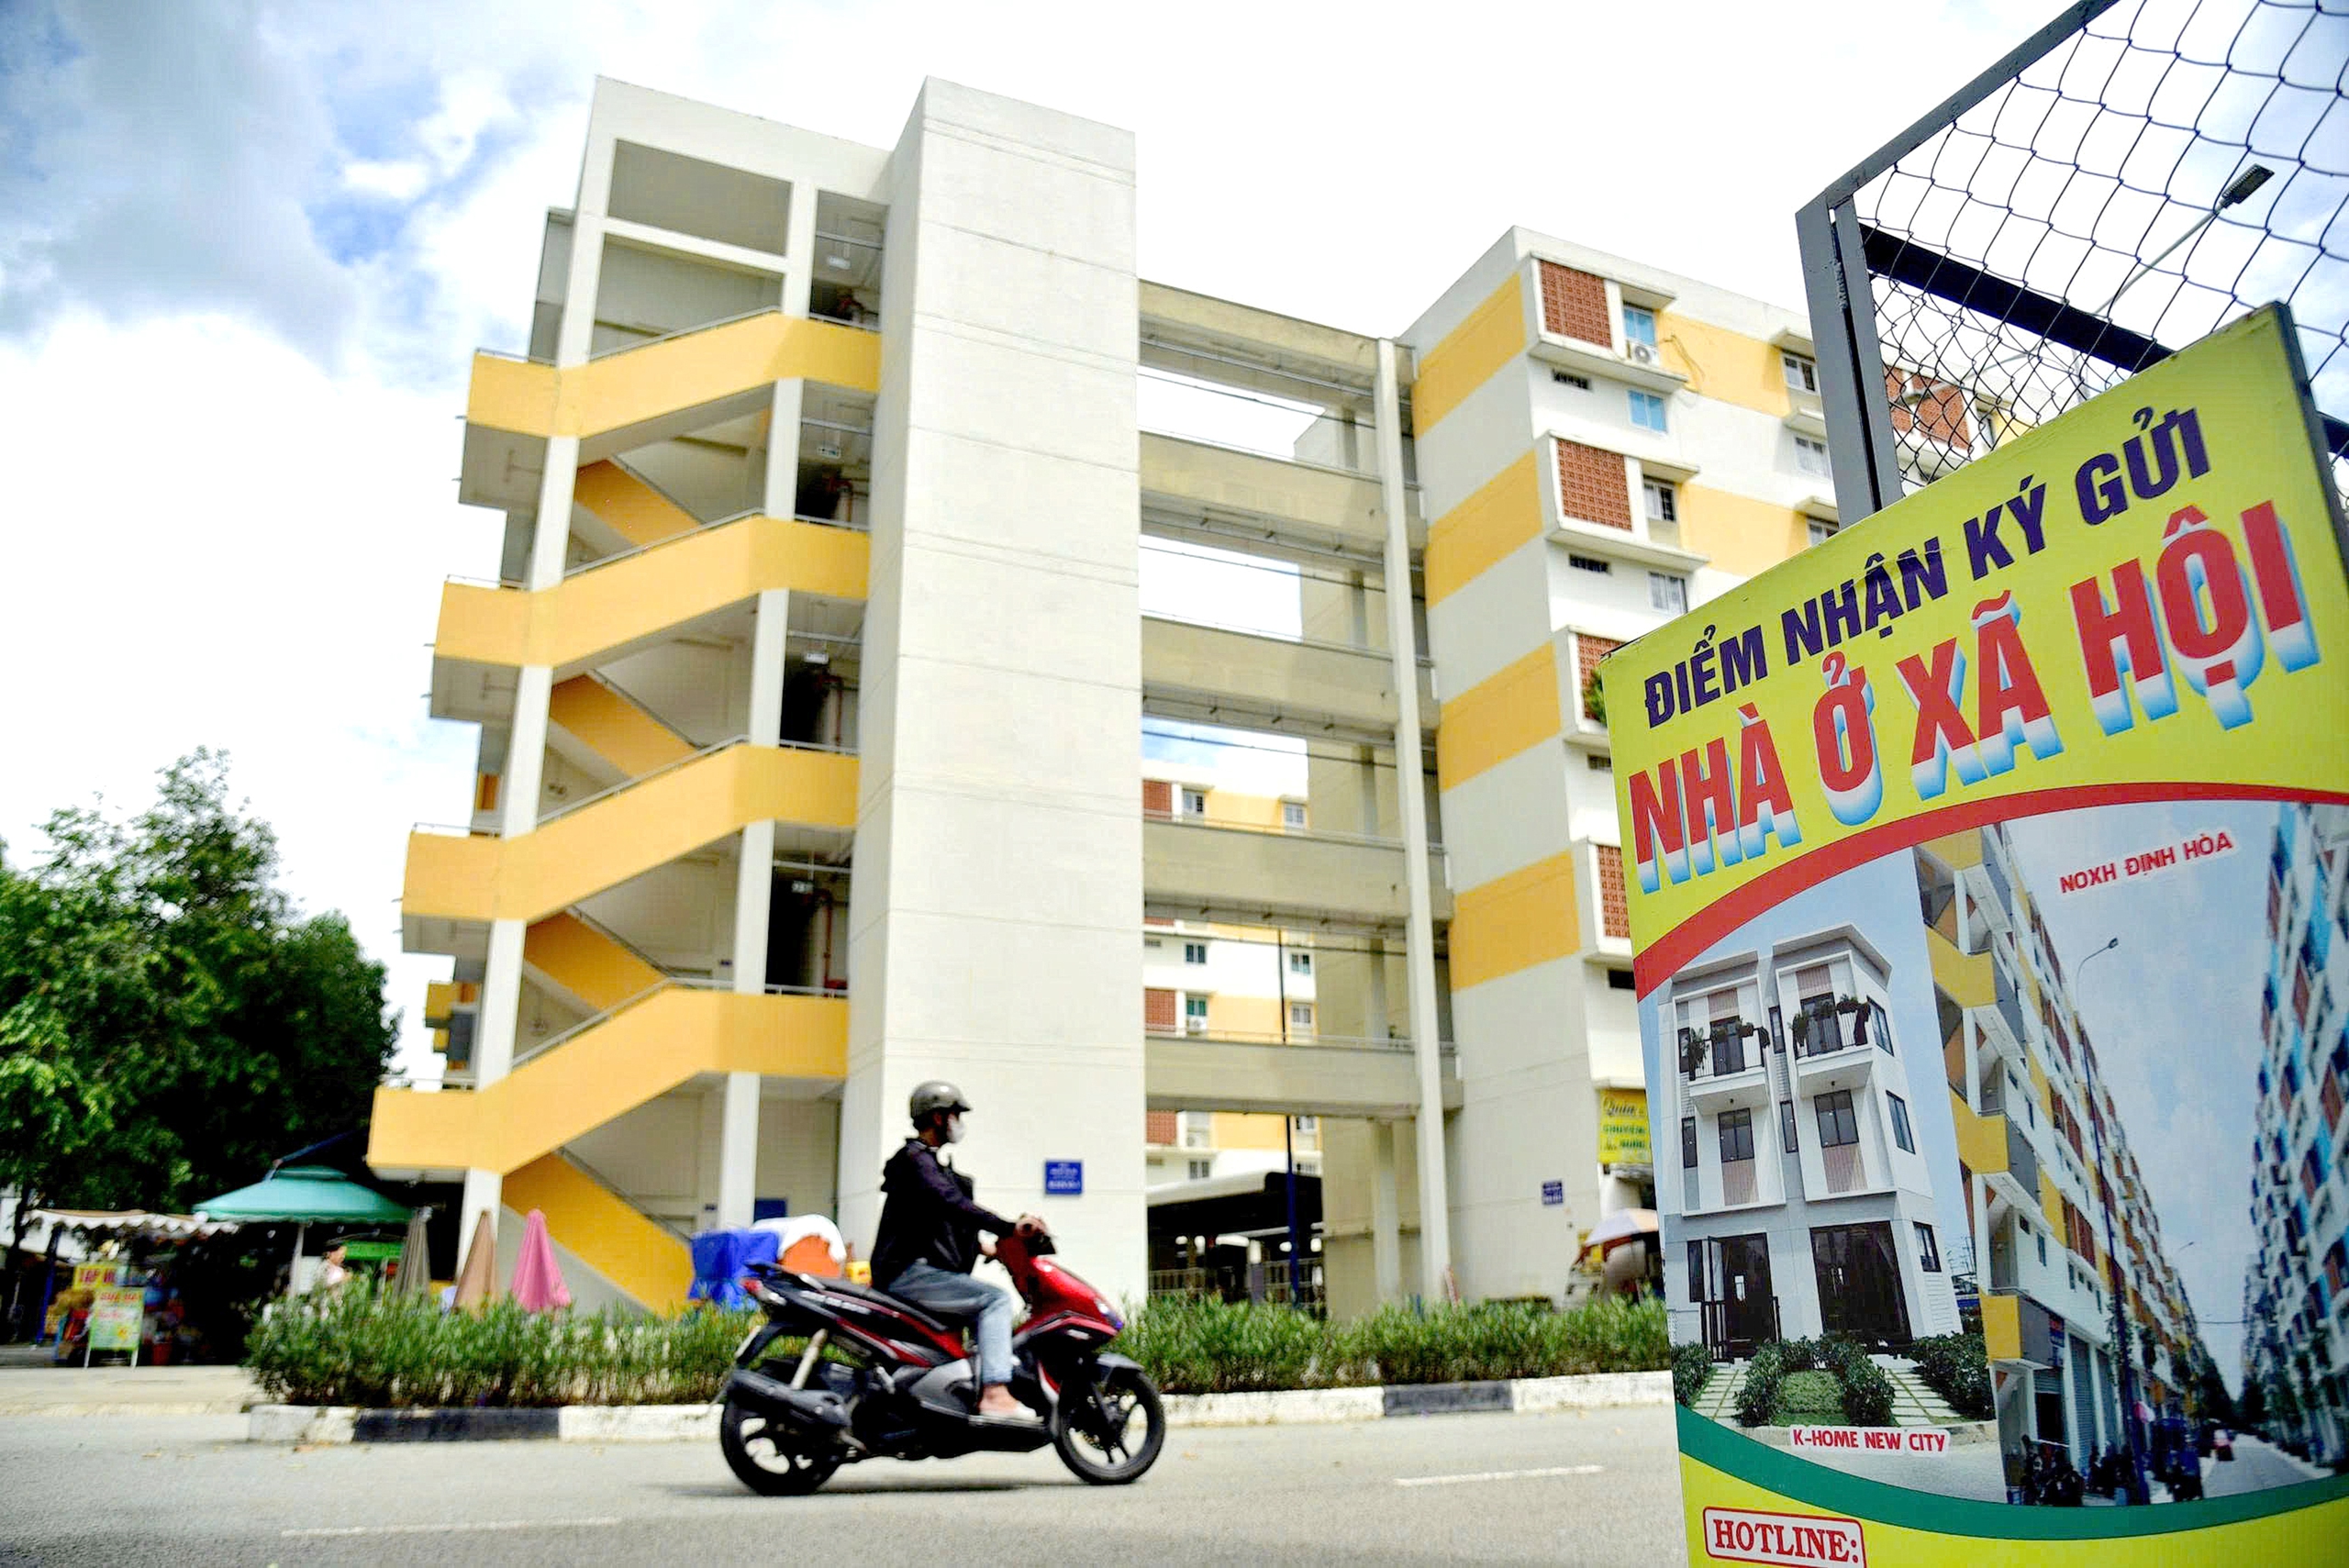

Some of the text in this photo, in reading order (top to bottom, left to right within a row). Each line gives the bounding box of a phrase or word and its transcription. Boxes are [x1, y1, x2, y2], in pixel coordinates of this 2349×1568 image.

[1644, 406, 2210, 728] ĐIỂM NHẬN KÝ GỬI
[1628, 499, 2321, 895] NHÀ Ở XÃ HỘI
[2059, 832, 2233, 894] NOXH ĐỊNH HÒA
[1792, 1429, 1945, 1452] K-HOME NEW CITY
[1713, 1518, 1860, 1563] HOTLINE:
